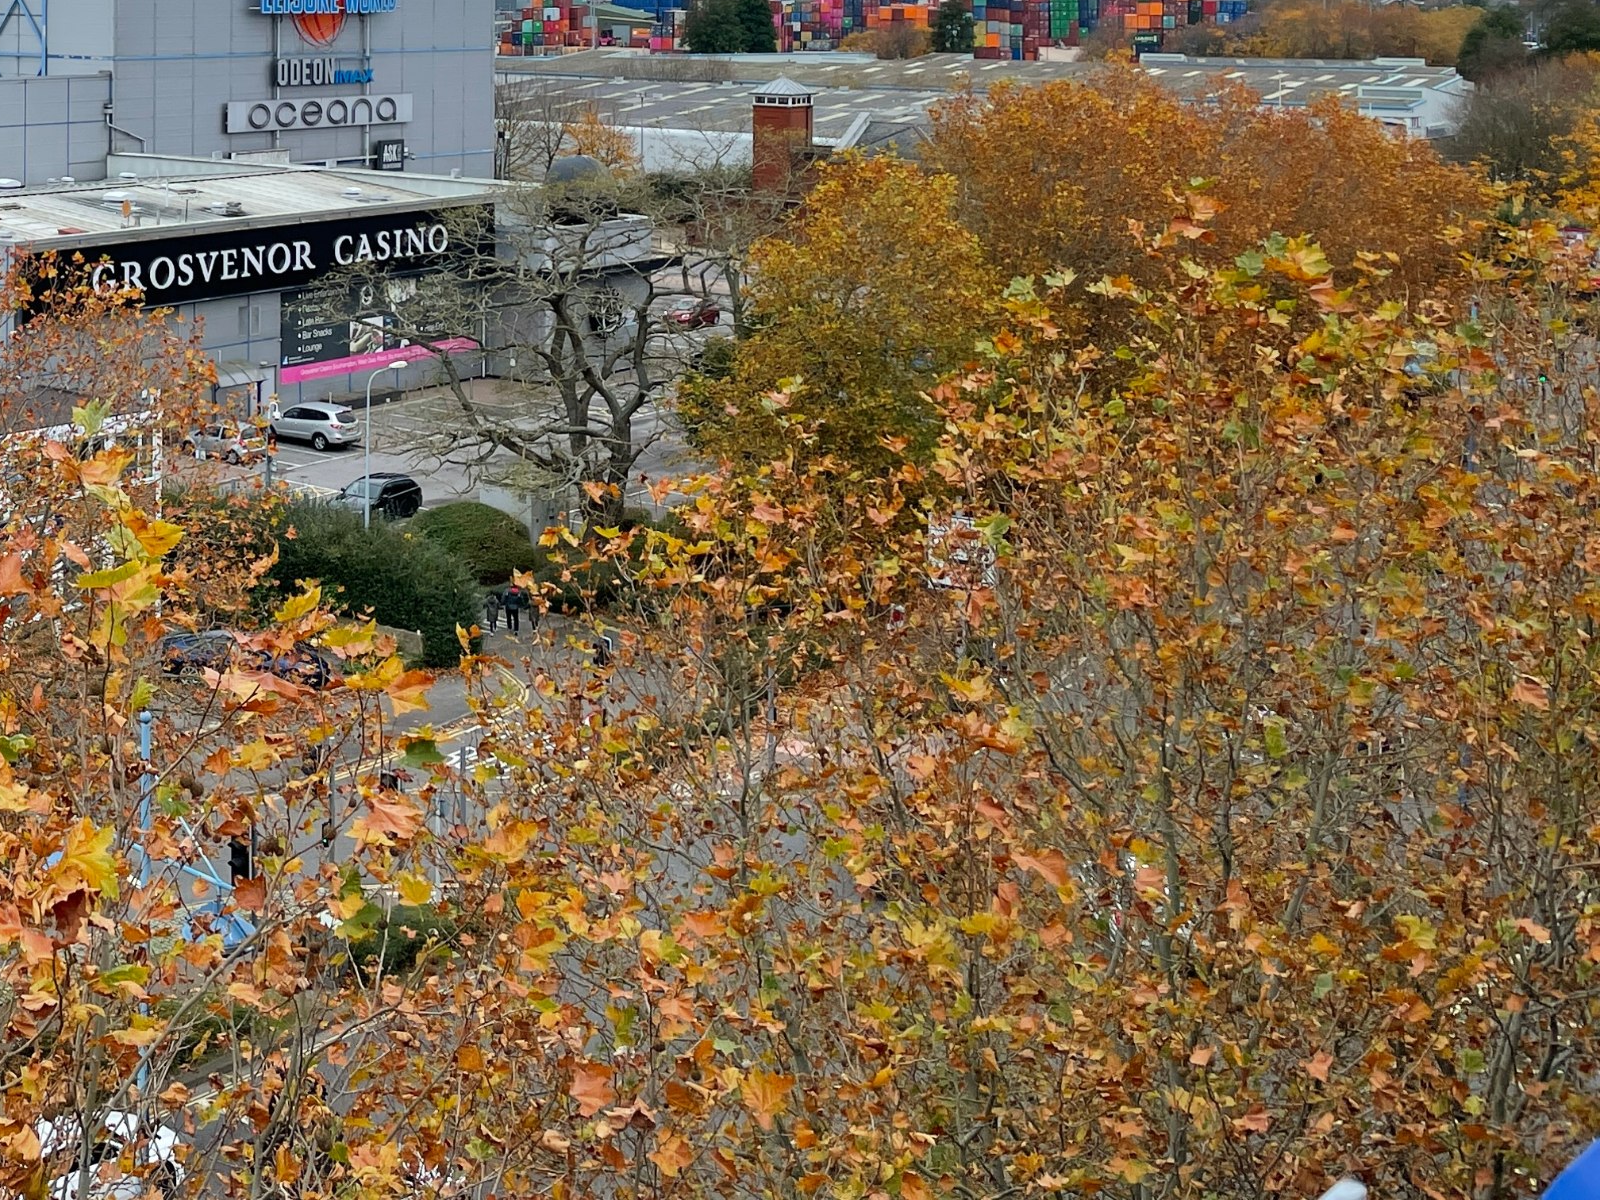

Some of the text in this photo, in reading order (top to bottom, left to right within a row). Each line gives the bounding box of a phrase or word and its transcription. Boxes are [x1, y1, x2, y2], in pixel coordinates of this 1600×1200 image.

[277, 58, 375, 86] ODEON IMAX
[248, 97, 397, 130] oceana
[383, 144, 398, 163] ASK
[92, 223, 449, 295] GROSVENOR CASINO
[302, 328, 333, 340] Bar Snacks
[302, 343, 323, 353] Lounge
